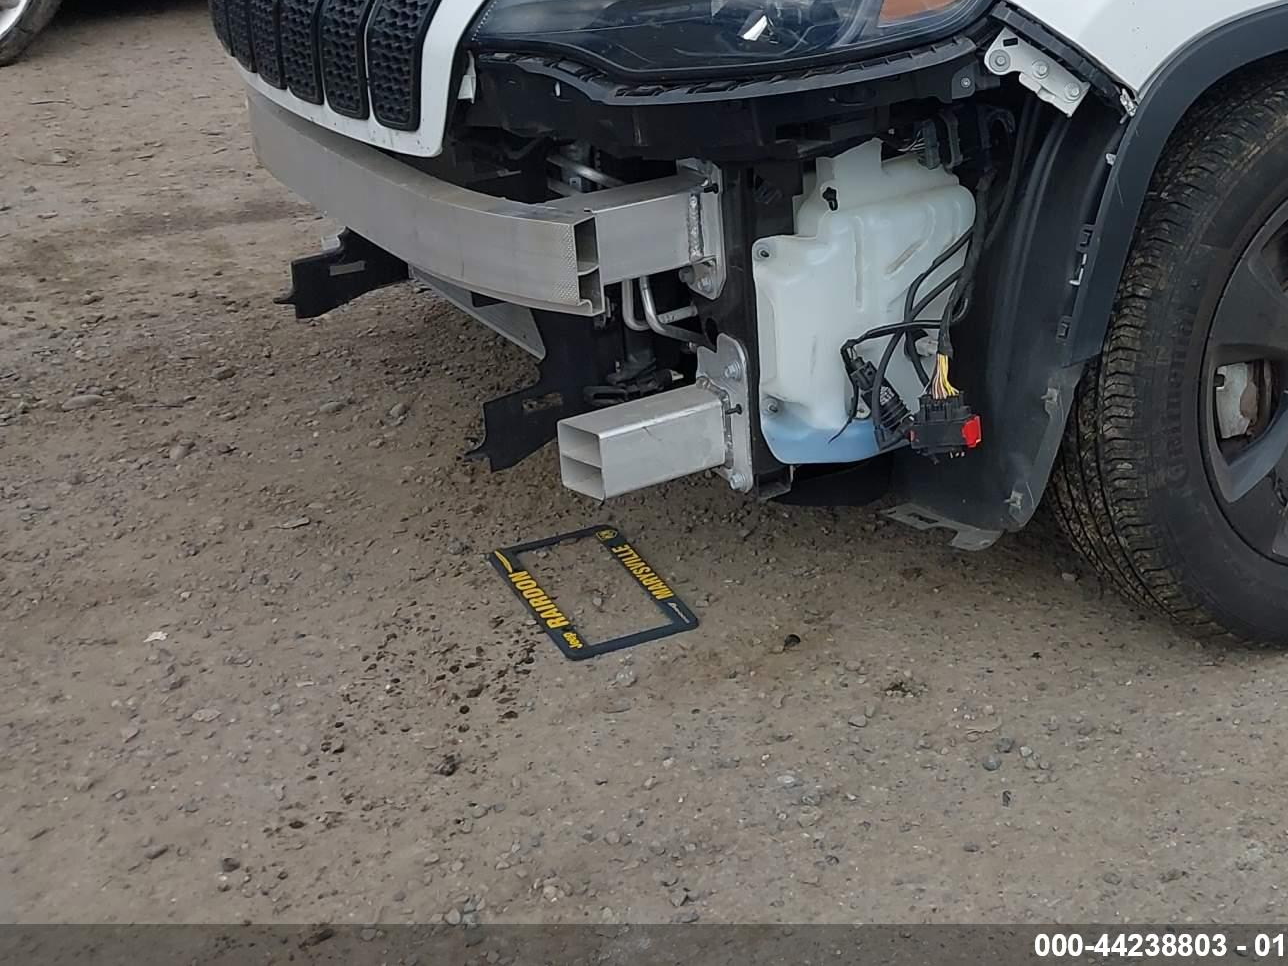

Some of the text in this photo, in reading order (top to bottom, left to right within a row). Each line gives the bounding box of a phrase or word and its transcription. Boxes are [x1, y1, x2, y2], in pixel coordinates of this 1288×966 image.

[612, 544, 675, 600] MARYSVILLE
[508, 570, 583, 649] Jeep RAIRDON
